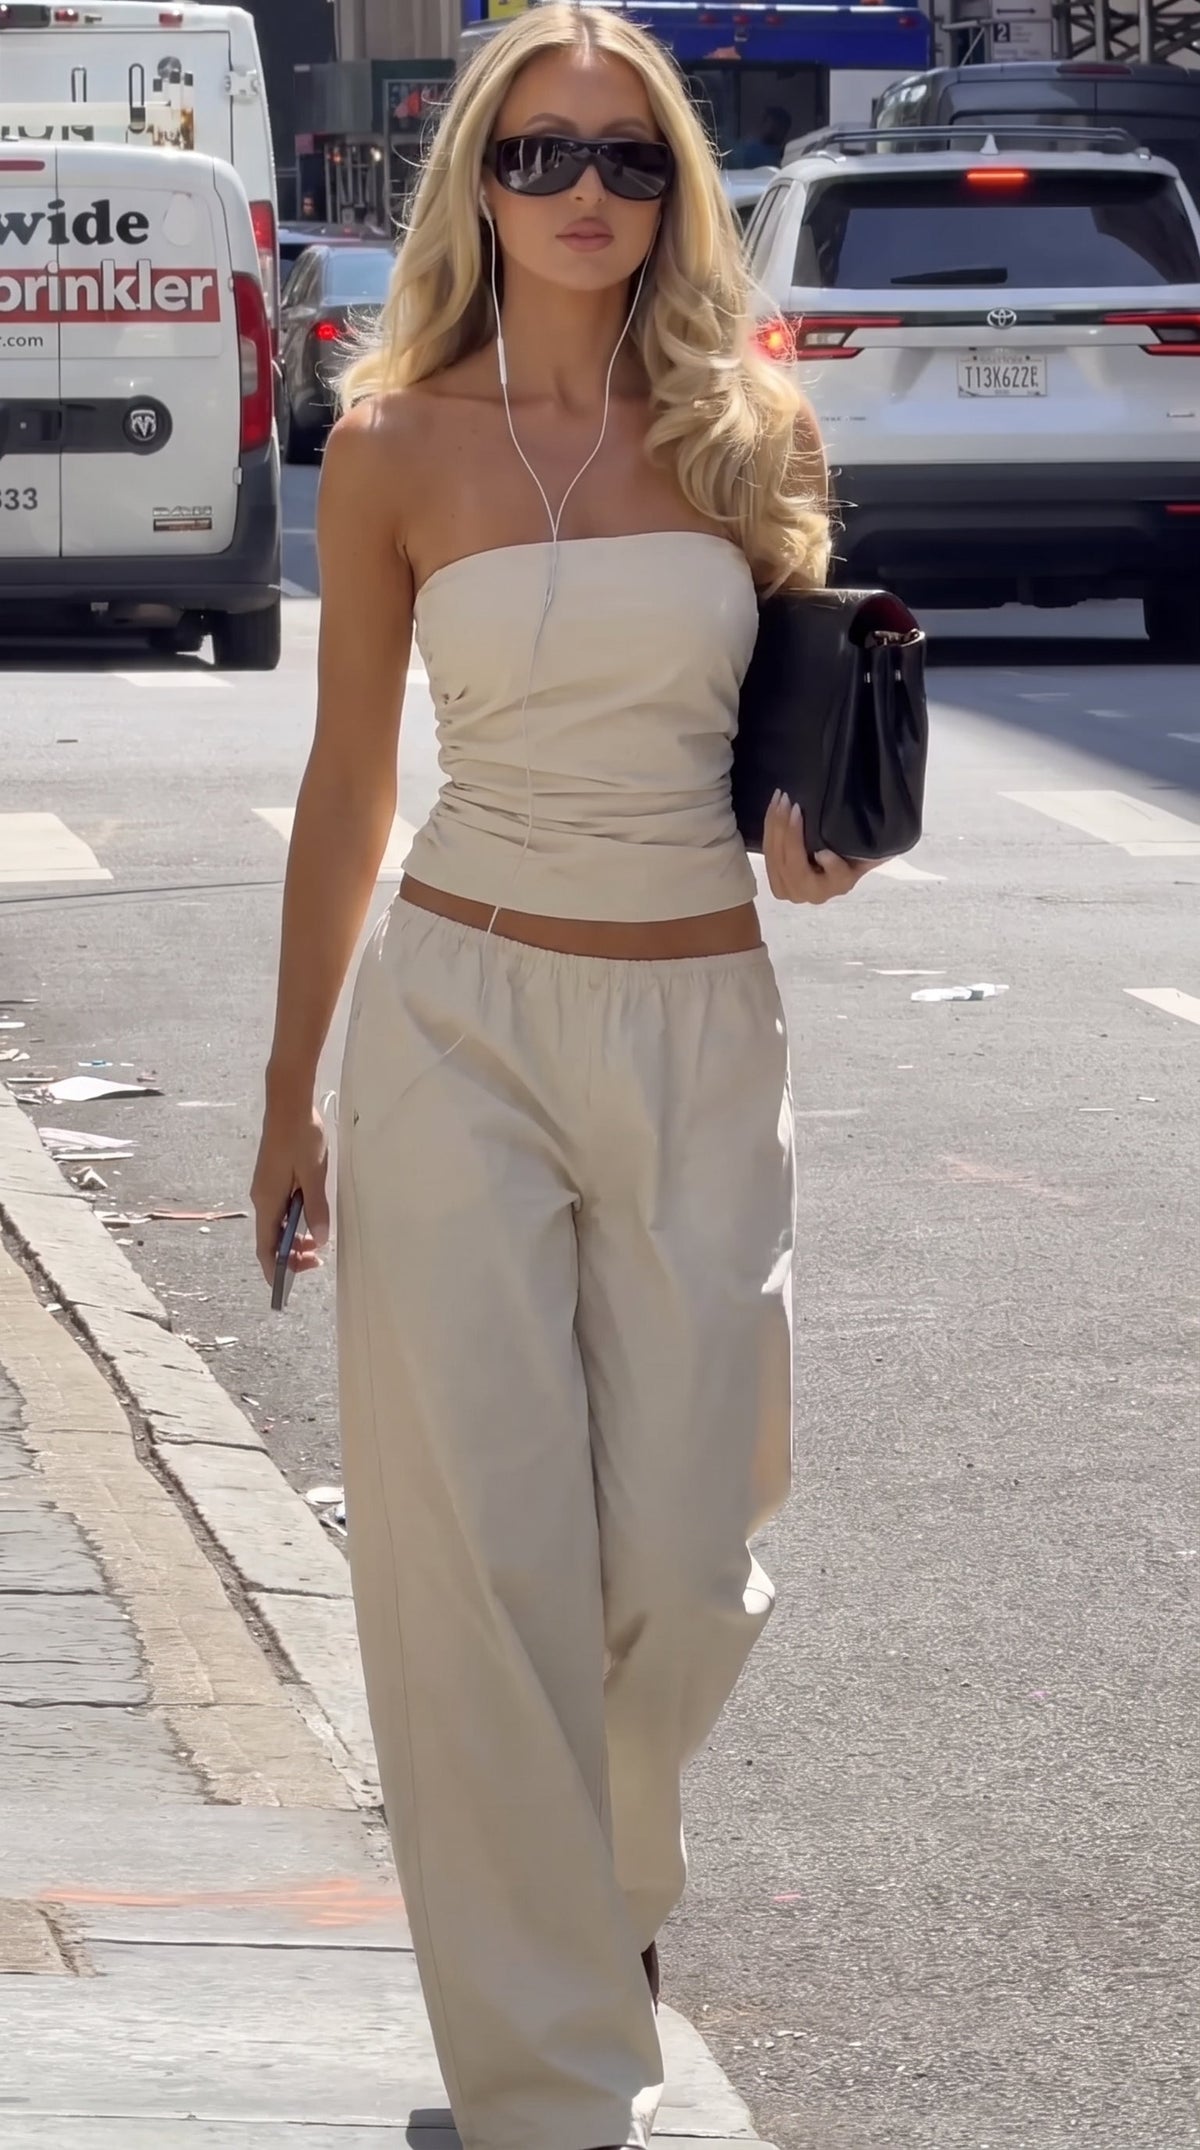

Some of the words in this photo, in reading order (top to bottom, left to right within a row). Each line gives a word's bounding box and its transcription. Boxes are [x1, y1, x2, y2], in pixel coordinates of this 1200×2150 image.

[997, 22, 1008, 42] 2
[0, 198, 150, 246] wide
[0, 336, 44, 348] .com
[0, 487, 38, 511] 33
